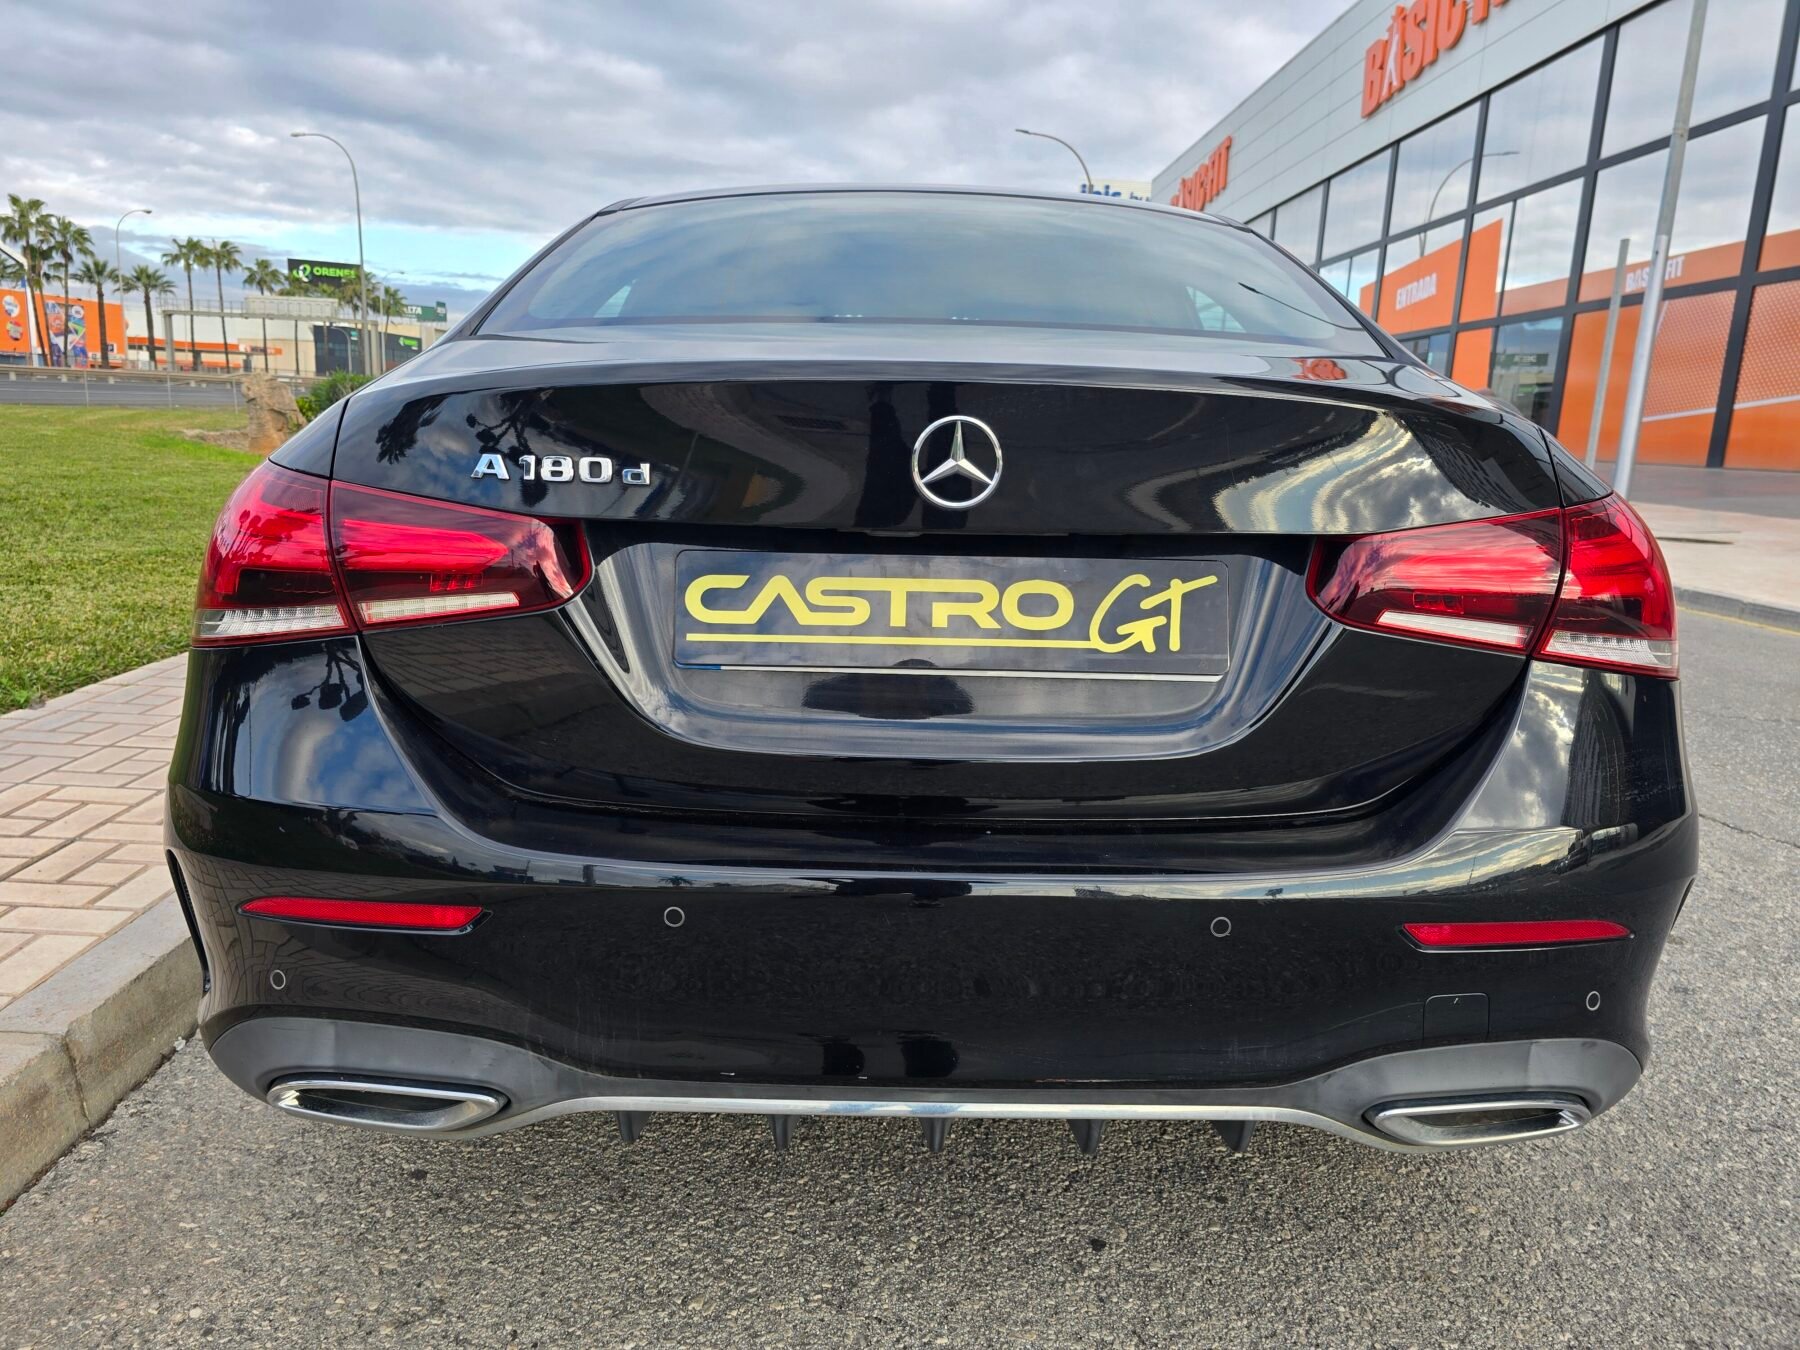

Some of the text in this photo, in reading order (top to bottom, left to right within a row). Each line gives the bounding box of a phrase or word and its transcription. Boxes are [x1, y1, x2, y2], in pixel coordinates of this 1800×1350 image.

[471, 453, 510, 480] A
[518, 455, 613, 484] 180
[684, 573, 1218, 653] CASTRO GT
